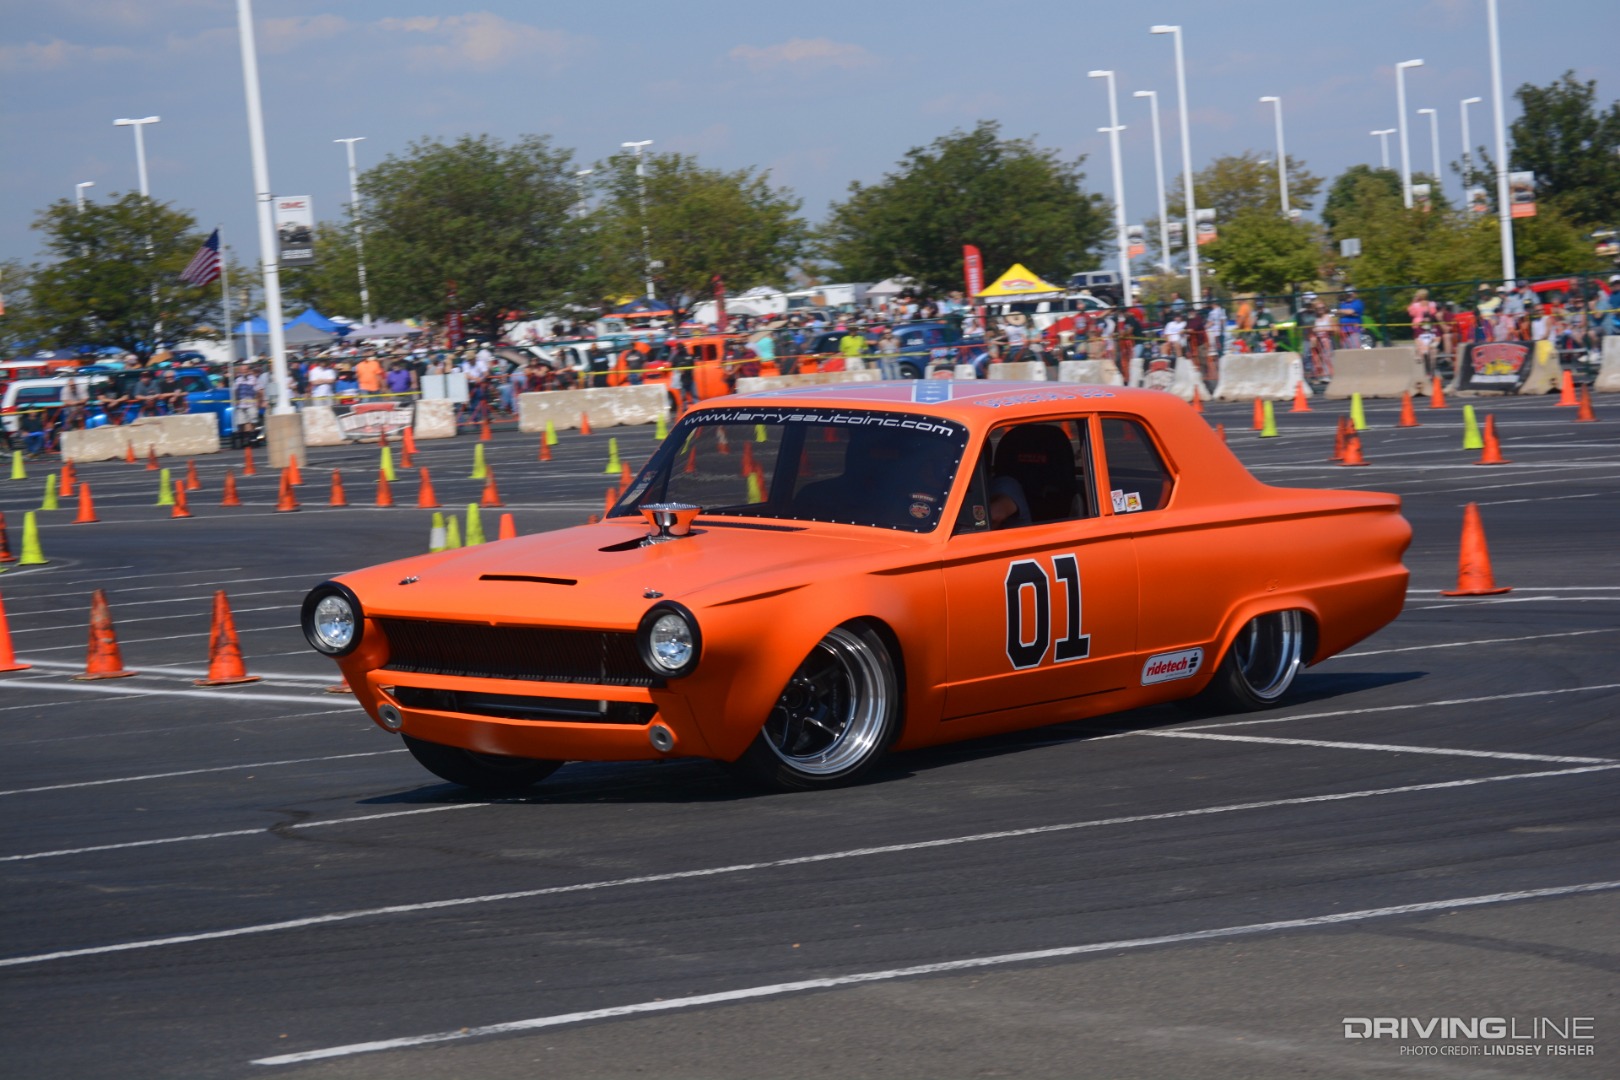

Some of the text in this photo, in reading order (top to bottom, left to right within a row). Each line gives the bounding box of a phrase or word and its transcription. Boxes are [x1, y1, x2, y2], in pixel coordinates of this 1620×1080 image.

[684, 411, 954, 437] www.larrysautoinc.com
[1004, 553, 1091, 670] 01
[1146, 656, 1188, 677] ridetech
